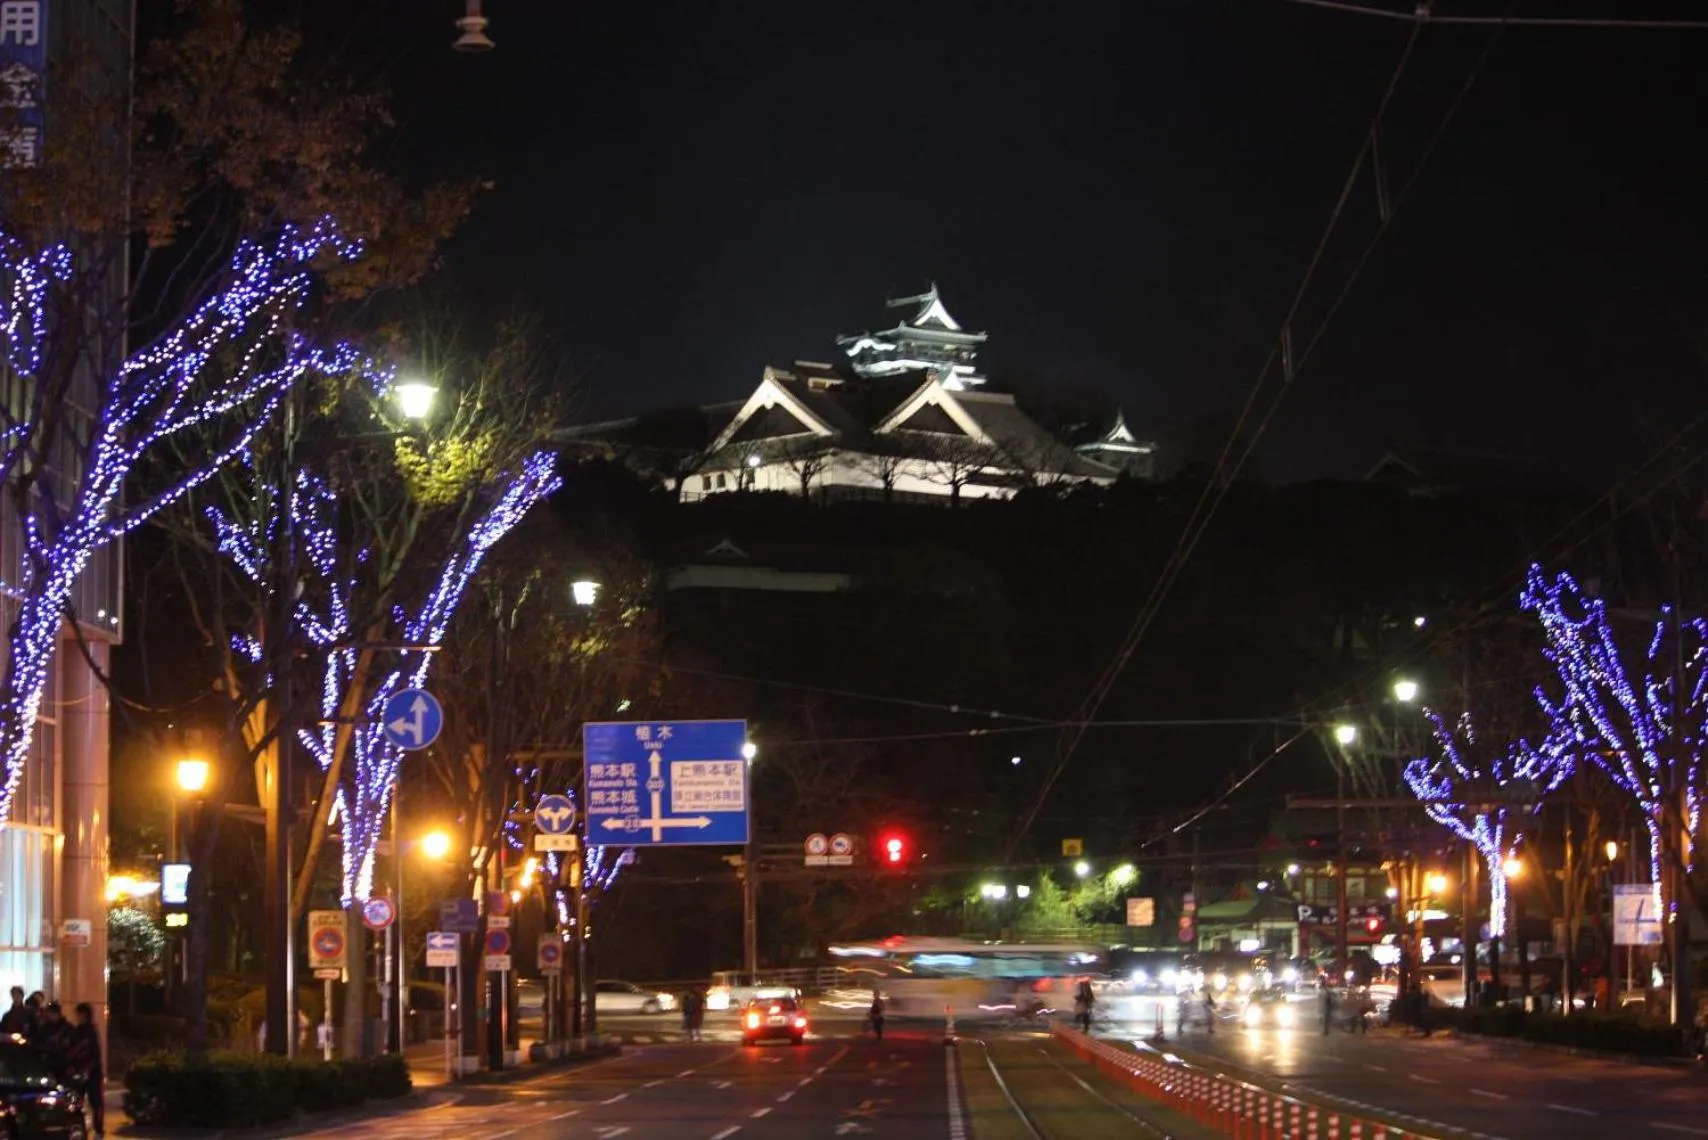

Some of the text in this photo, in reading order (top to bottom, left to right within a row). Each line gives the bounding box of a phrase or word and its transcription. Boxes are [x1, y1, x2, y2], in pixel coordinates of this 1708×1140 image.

[590, 763, 636, 778] 熊本駅
[678, 764, 738, 778] 上熊本駅
[590, 790, 637, 806] 熊本城
